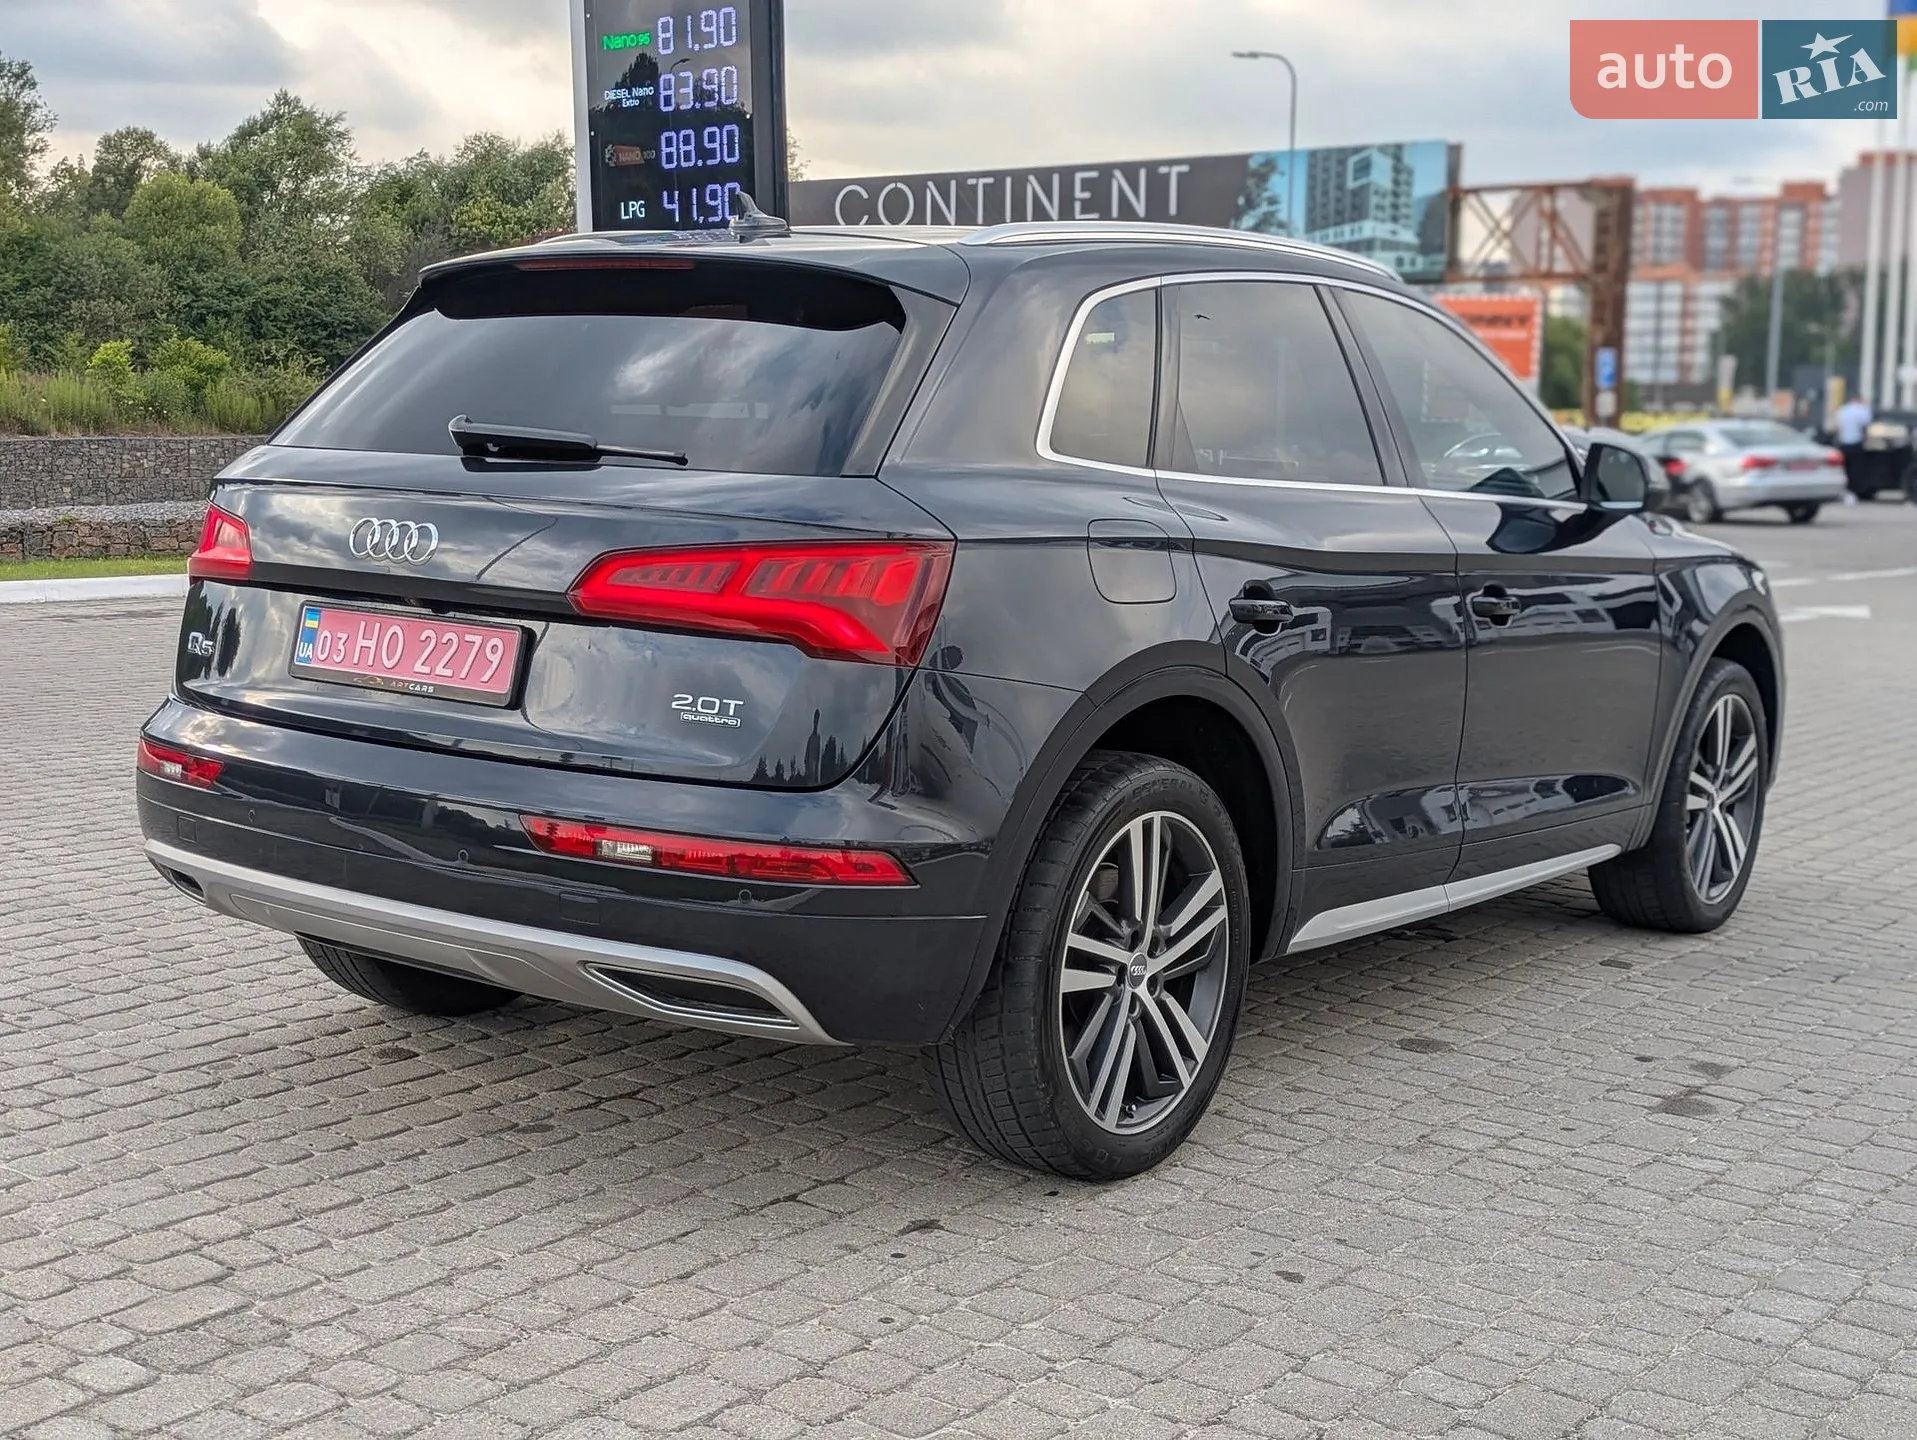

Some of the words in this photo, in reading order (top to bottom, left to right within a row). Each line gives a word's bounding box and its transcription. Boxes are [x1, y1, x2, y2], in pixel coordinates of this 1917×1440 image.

[658, 7, 737, 55] 81.90
[604, 89, 631, 100] DIESEL
[632, 86, 655, 97] Nano
[659, 65, 738, 112] 83.90
[661, 124, 739, 169] 88.90
[835, 164, 1190, 226] CONTINENT
[621, 201, 646, 219] LPG
[188, 631, 214, 657] Q5
[298, 641, 313, 659] UA
[317, 630, 350, 664] 03
[413, 628, 506, 683] 2279
[671, 693, 744, 716] 2.0T
[683, 713, 738, 726] quattro
